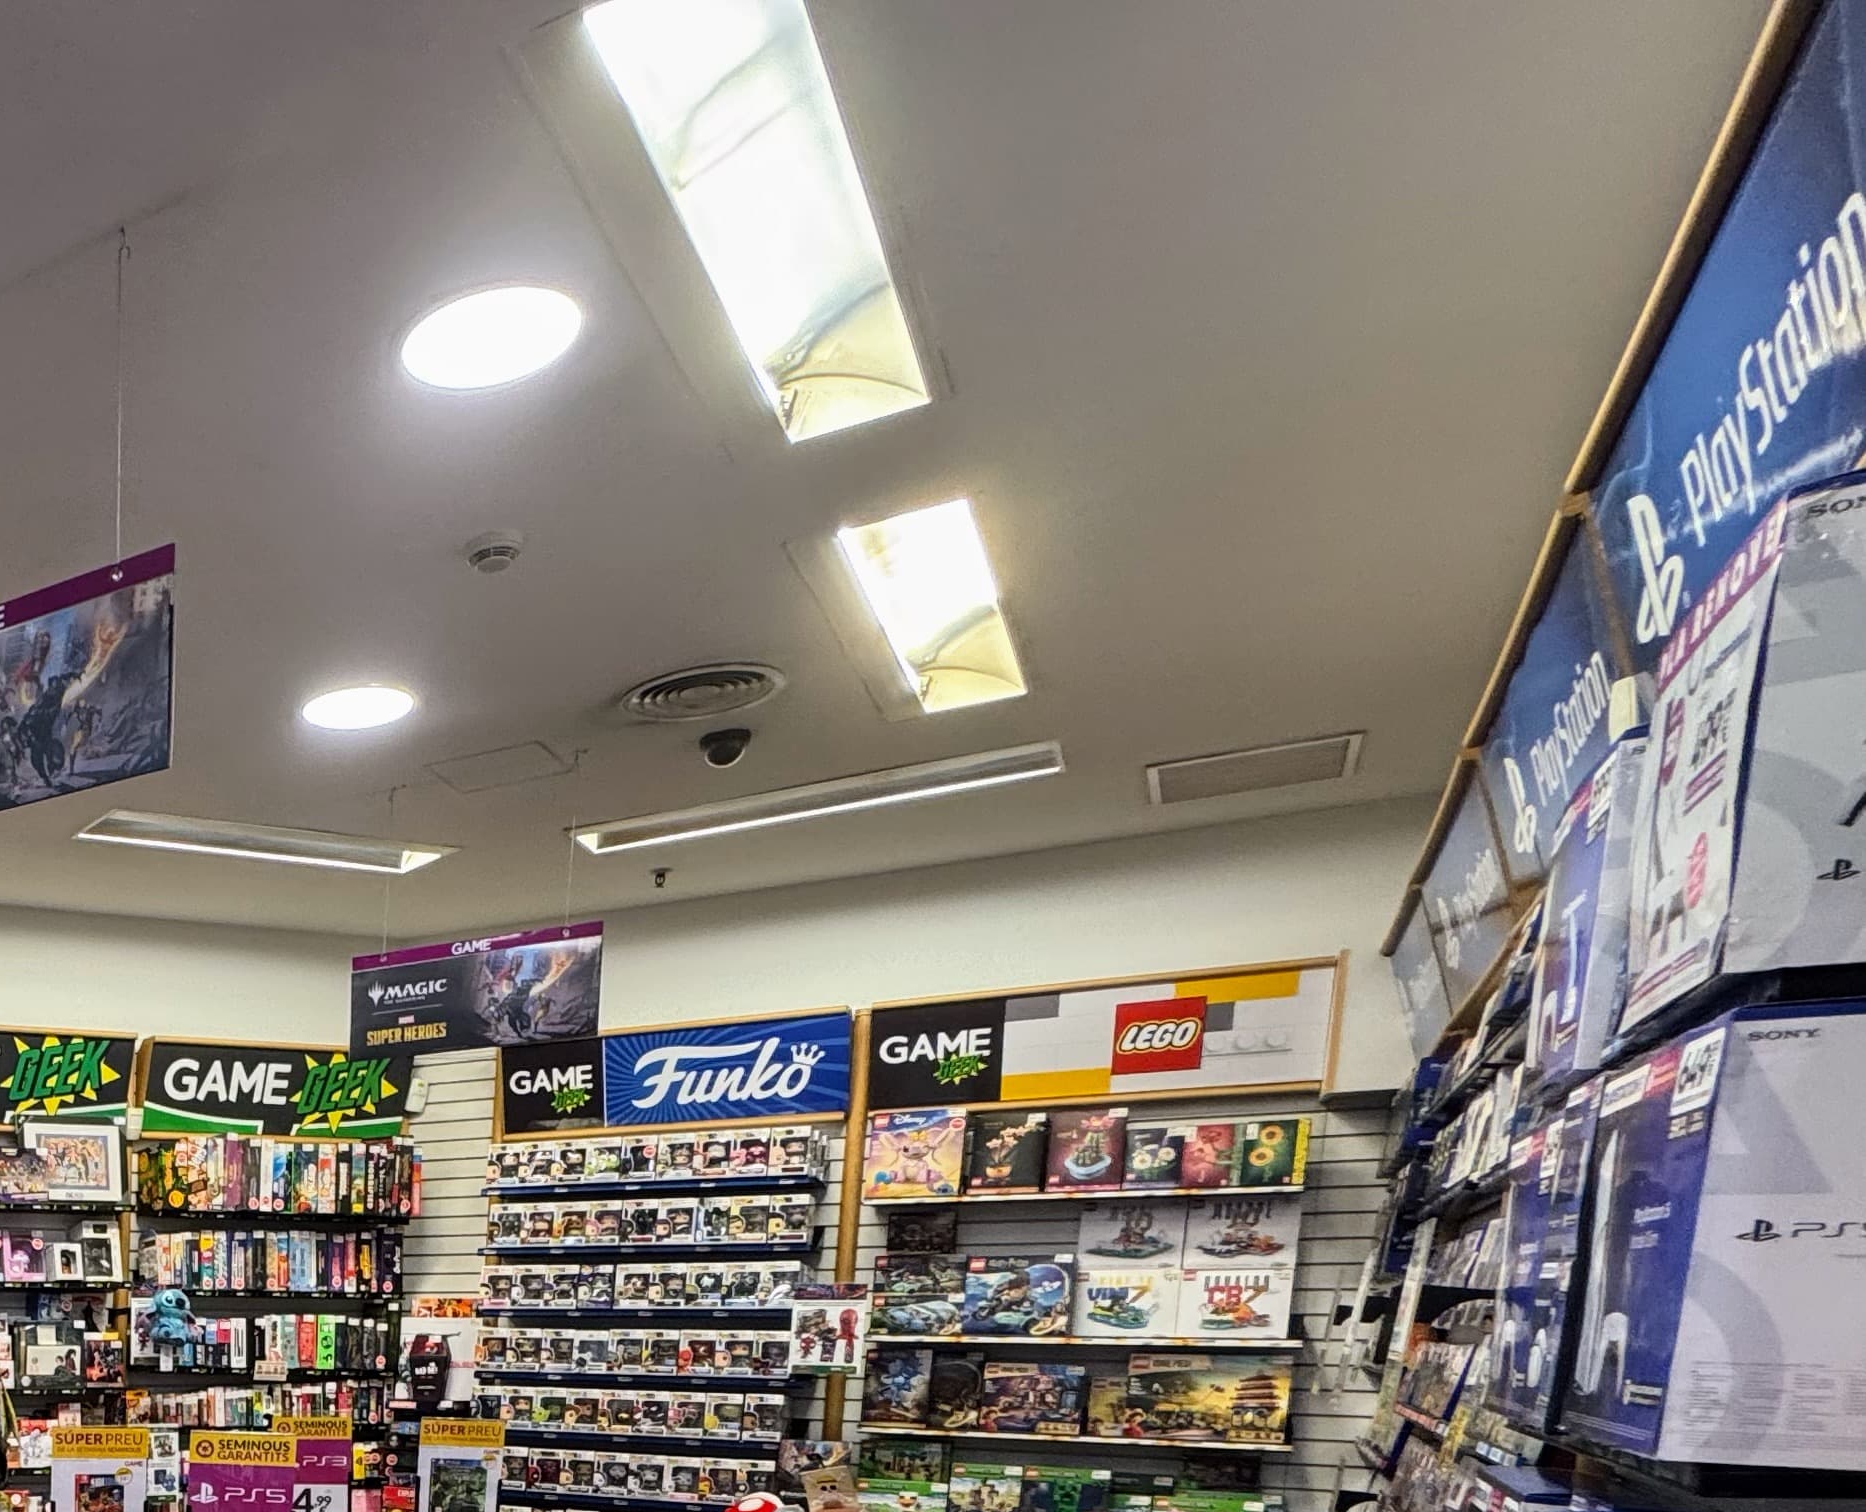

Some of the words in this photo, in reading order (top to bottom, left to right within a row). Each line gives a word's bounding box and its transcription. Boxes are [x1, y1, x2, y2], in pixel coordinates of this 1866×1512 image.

[1680, 191, 1866, 546] PlayStation
[1530, 651, 1611, 806] PlayStation
[452, 939, 491, 955] GAME
[384, 979, 447, 999] MAGIC
[367, 1028, 402, 1046] SUPER
[404, 1022, 447, 1042] HEROES
[1118, 1016, 1201, 1054] LEGO
[1748, 1028, 1821, 1041] SONY
[879, 1028, 991, 1064] GAME
[9, 1040, 110, 1101] GEEK
[510, 1064, 593, 1094] GAME
[631, 1037, 817, 1109] Funko
[164, 1058, 293, 1104] GAME
[296, 1057, 390, 1115] GEEK
[293, 1421, 347, 1431] SEMINOUS
[424, 1421, 465, 1436] SÚPER
[468, 1424, 502, 1437] PREU
[55, 1430, 103, 1445] SÚPER
[105, 1430, 143, 1445] PREU
[218, 1440, 291, 1452] SEMINOUS
[217, 1450, 290, 1463] GARANTITS
[303, 1455, 347, 1467] PS3
[225, 1488, 287, 1504] PS5
